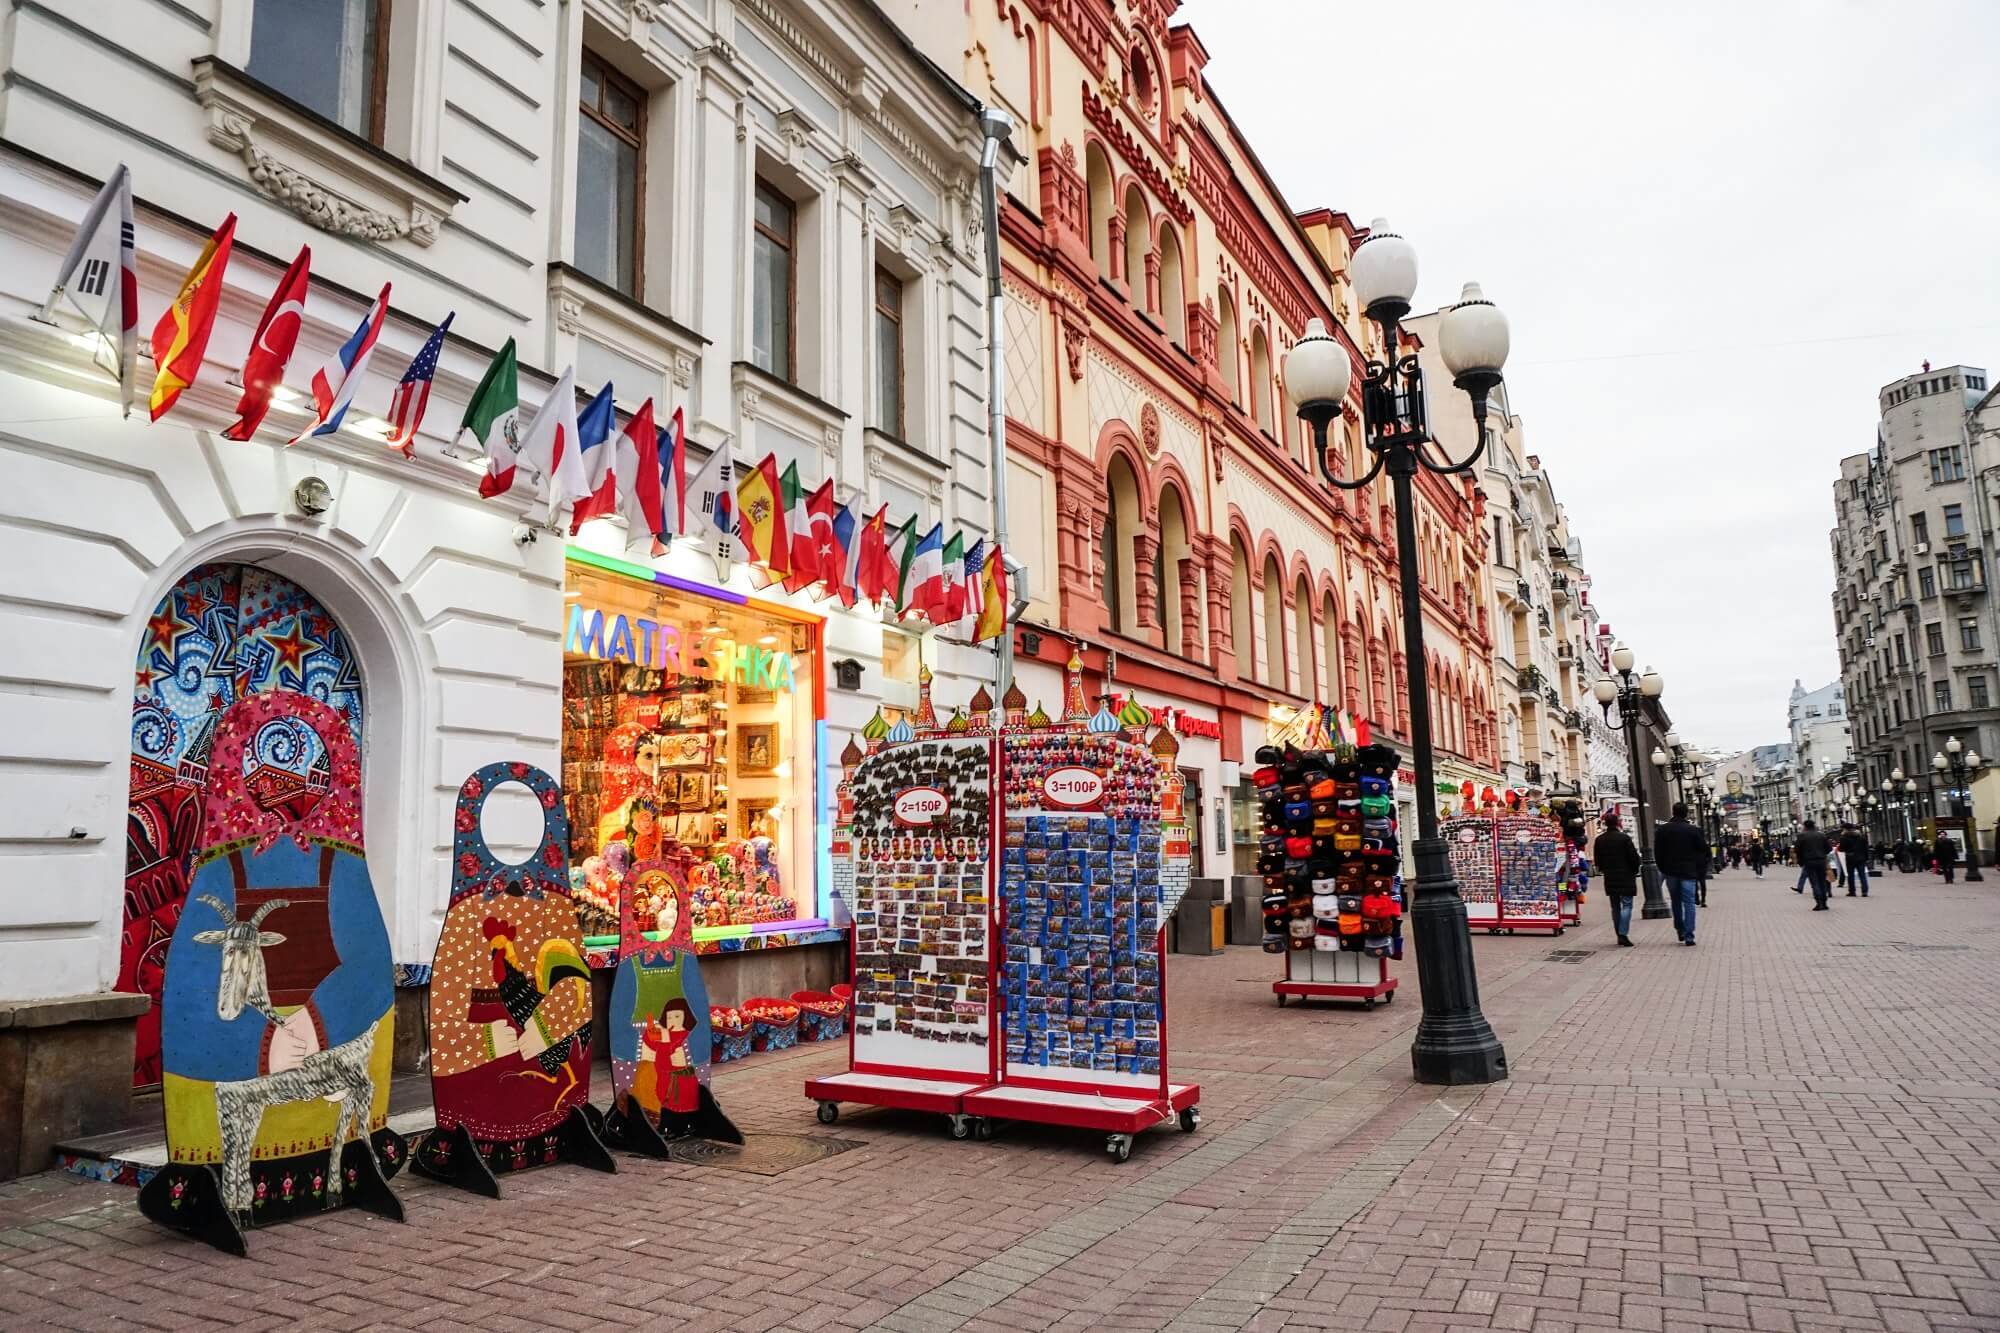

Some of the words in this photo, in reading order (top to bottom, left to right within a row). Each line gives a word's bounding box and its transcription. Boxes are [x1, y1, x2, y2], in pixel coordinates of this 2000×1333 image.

[1175, 709, 1221, 740] Теремок
[1051, 780, 1097, 793] 3=100₽
[901, 800, 942, 813] 2=150₽
